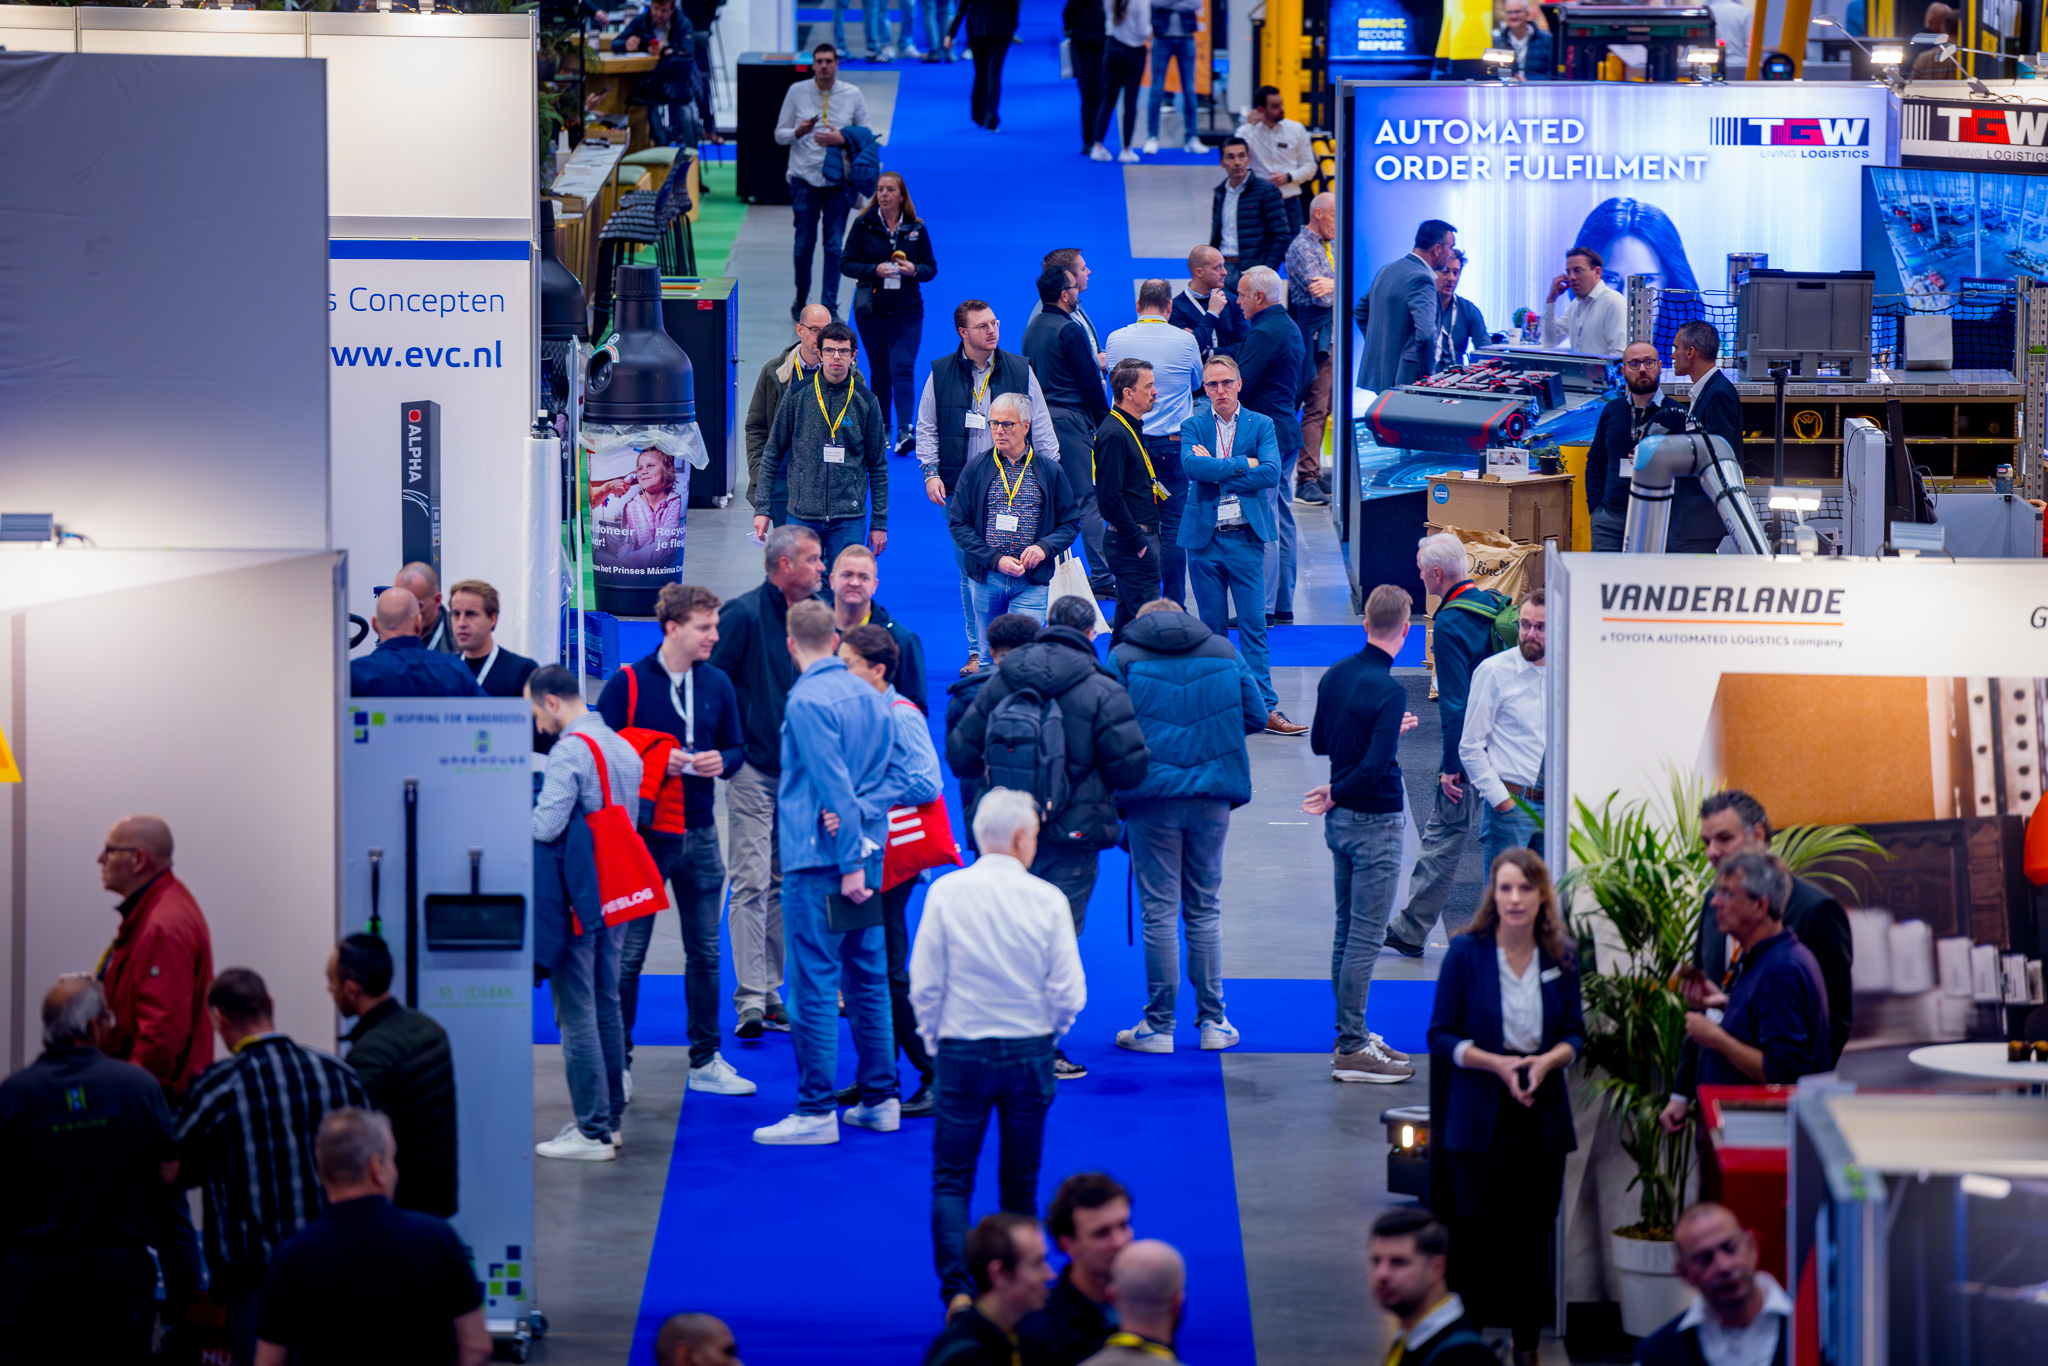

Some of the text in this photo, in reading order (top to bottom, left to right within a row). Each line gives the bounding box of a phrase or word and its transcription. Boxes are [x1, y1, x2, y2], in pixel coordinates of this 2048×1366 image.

[1374, 118, 1585, 145] AUTOMATED
[1748, 118, 1867, 146] TGW
[1937, 106, 2048, 147] TGW
[1760, 150, 1870, 159] LIVING LOGISTICS
[1948, 147, 1983, 158] LIVING
[1374, 155, 1709, 181] ORDER FULFILMENT
[349, 287, 505, 318] Concepten
[408, 424, 422, 483] ALPHA
[596, 524, 635, 536] doneer
[655, 539, 668, 551] je
[601, 564, 612, 573] het
[613, 566, 645, 575] Prinses
[647, 565, 675, 575] Máxima
[1601, 583, 1846, 614] VANDERLANDE
[1610, 632, 1654, 643] TOYOTA
[1657, 634, 1728, 645] AUTOMATED
[1731, 635, 1790, 646] LOGISTICS
[1792, 636, 1844, 649] company
